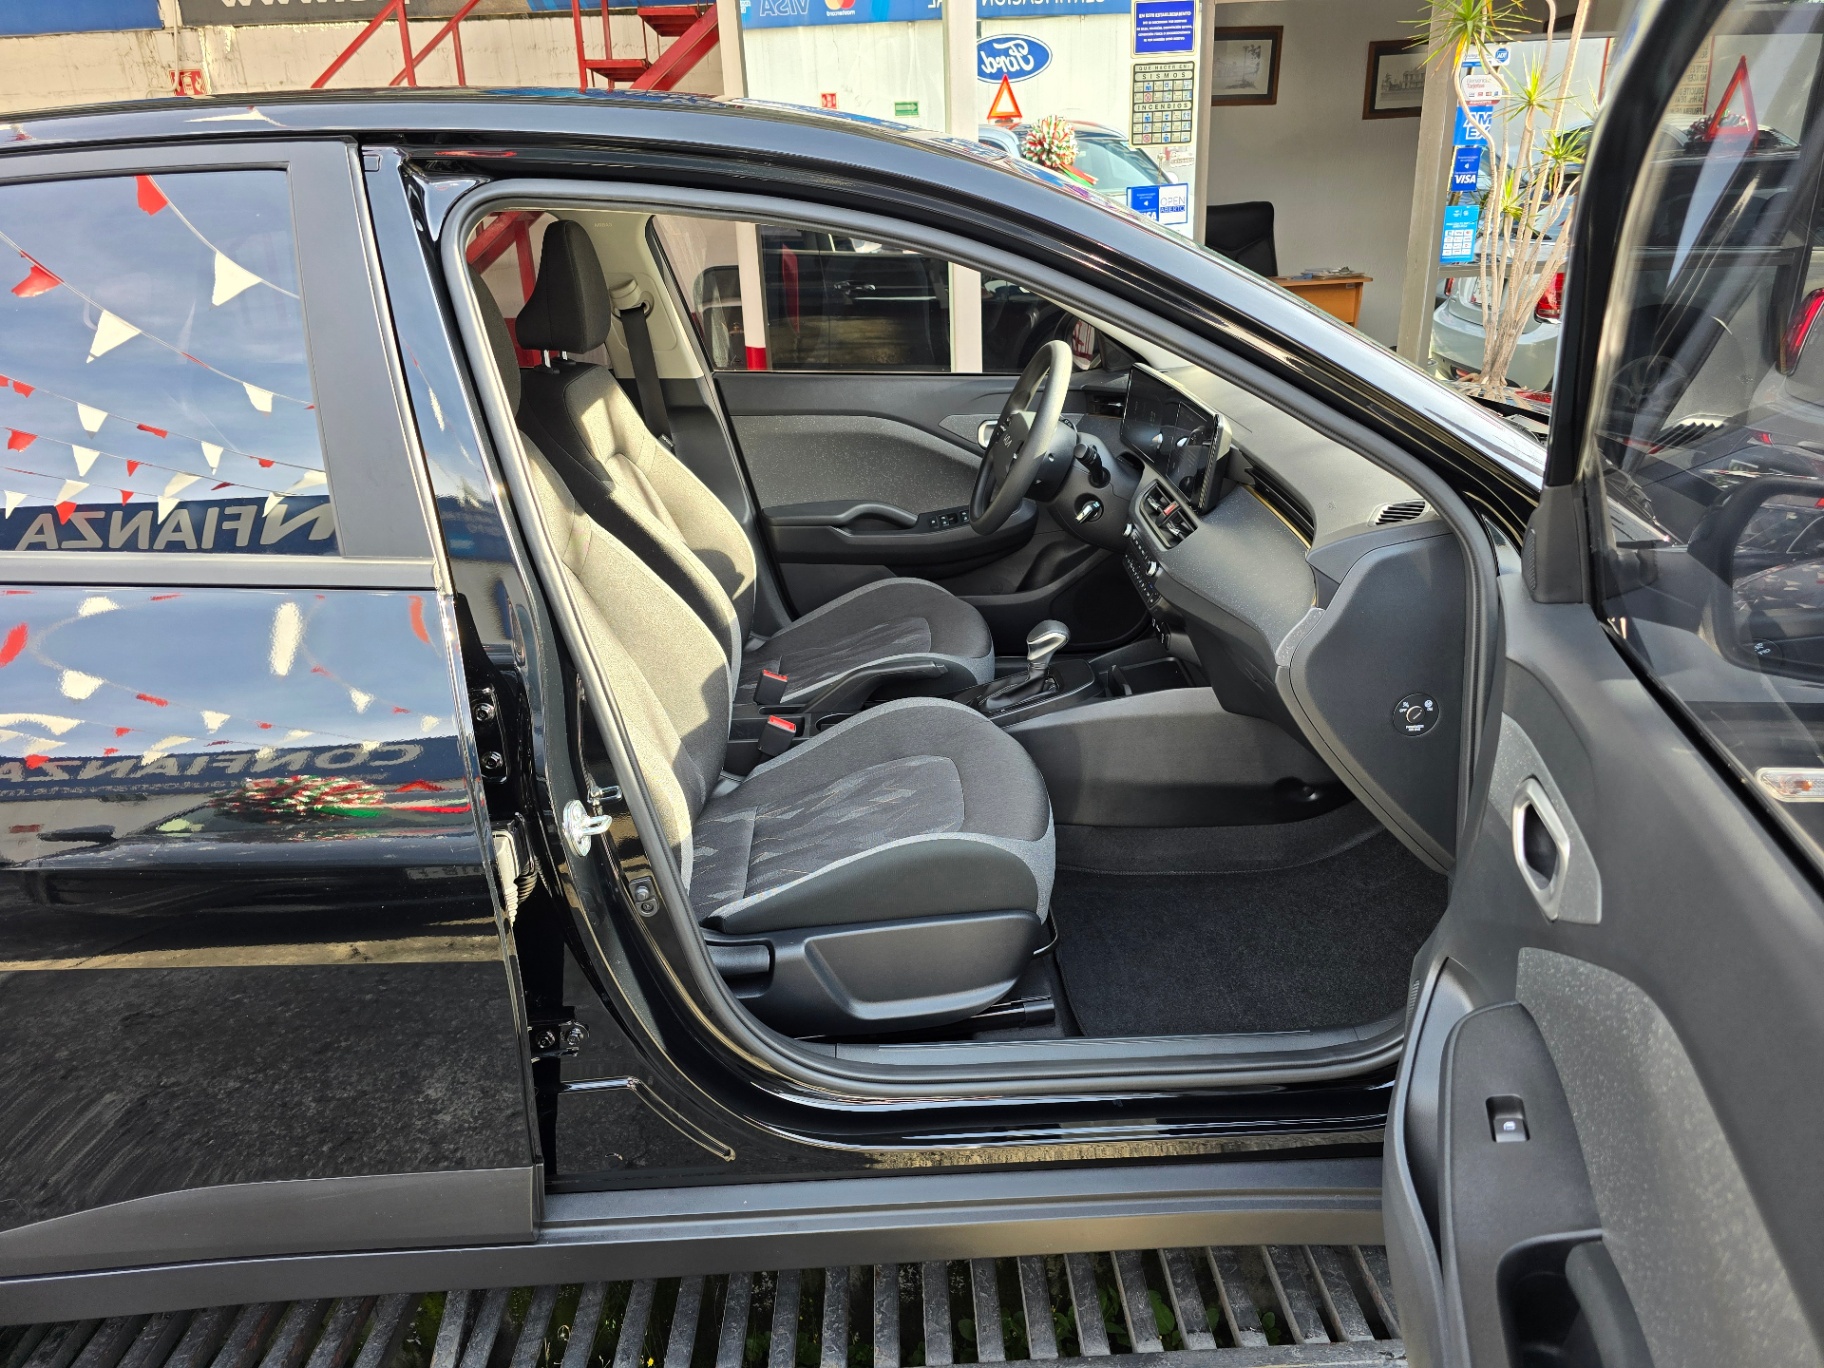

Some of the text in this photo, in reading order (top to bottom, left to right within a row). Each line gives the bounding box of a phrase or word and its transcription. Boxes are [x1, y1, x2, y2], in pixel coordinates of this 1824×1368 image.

[1142, 72, 1186, 80] SISMOS
[1138, 103, 1188, 111] INCENDIOS
[1454, 174, 1477, 184] VISA
[1160, 196, 1185, 206] OPEN
[1160, 205, 1185, 213] ABIERTO
